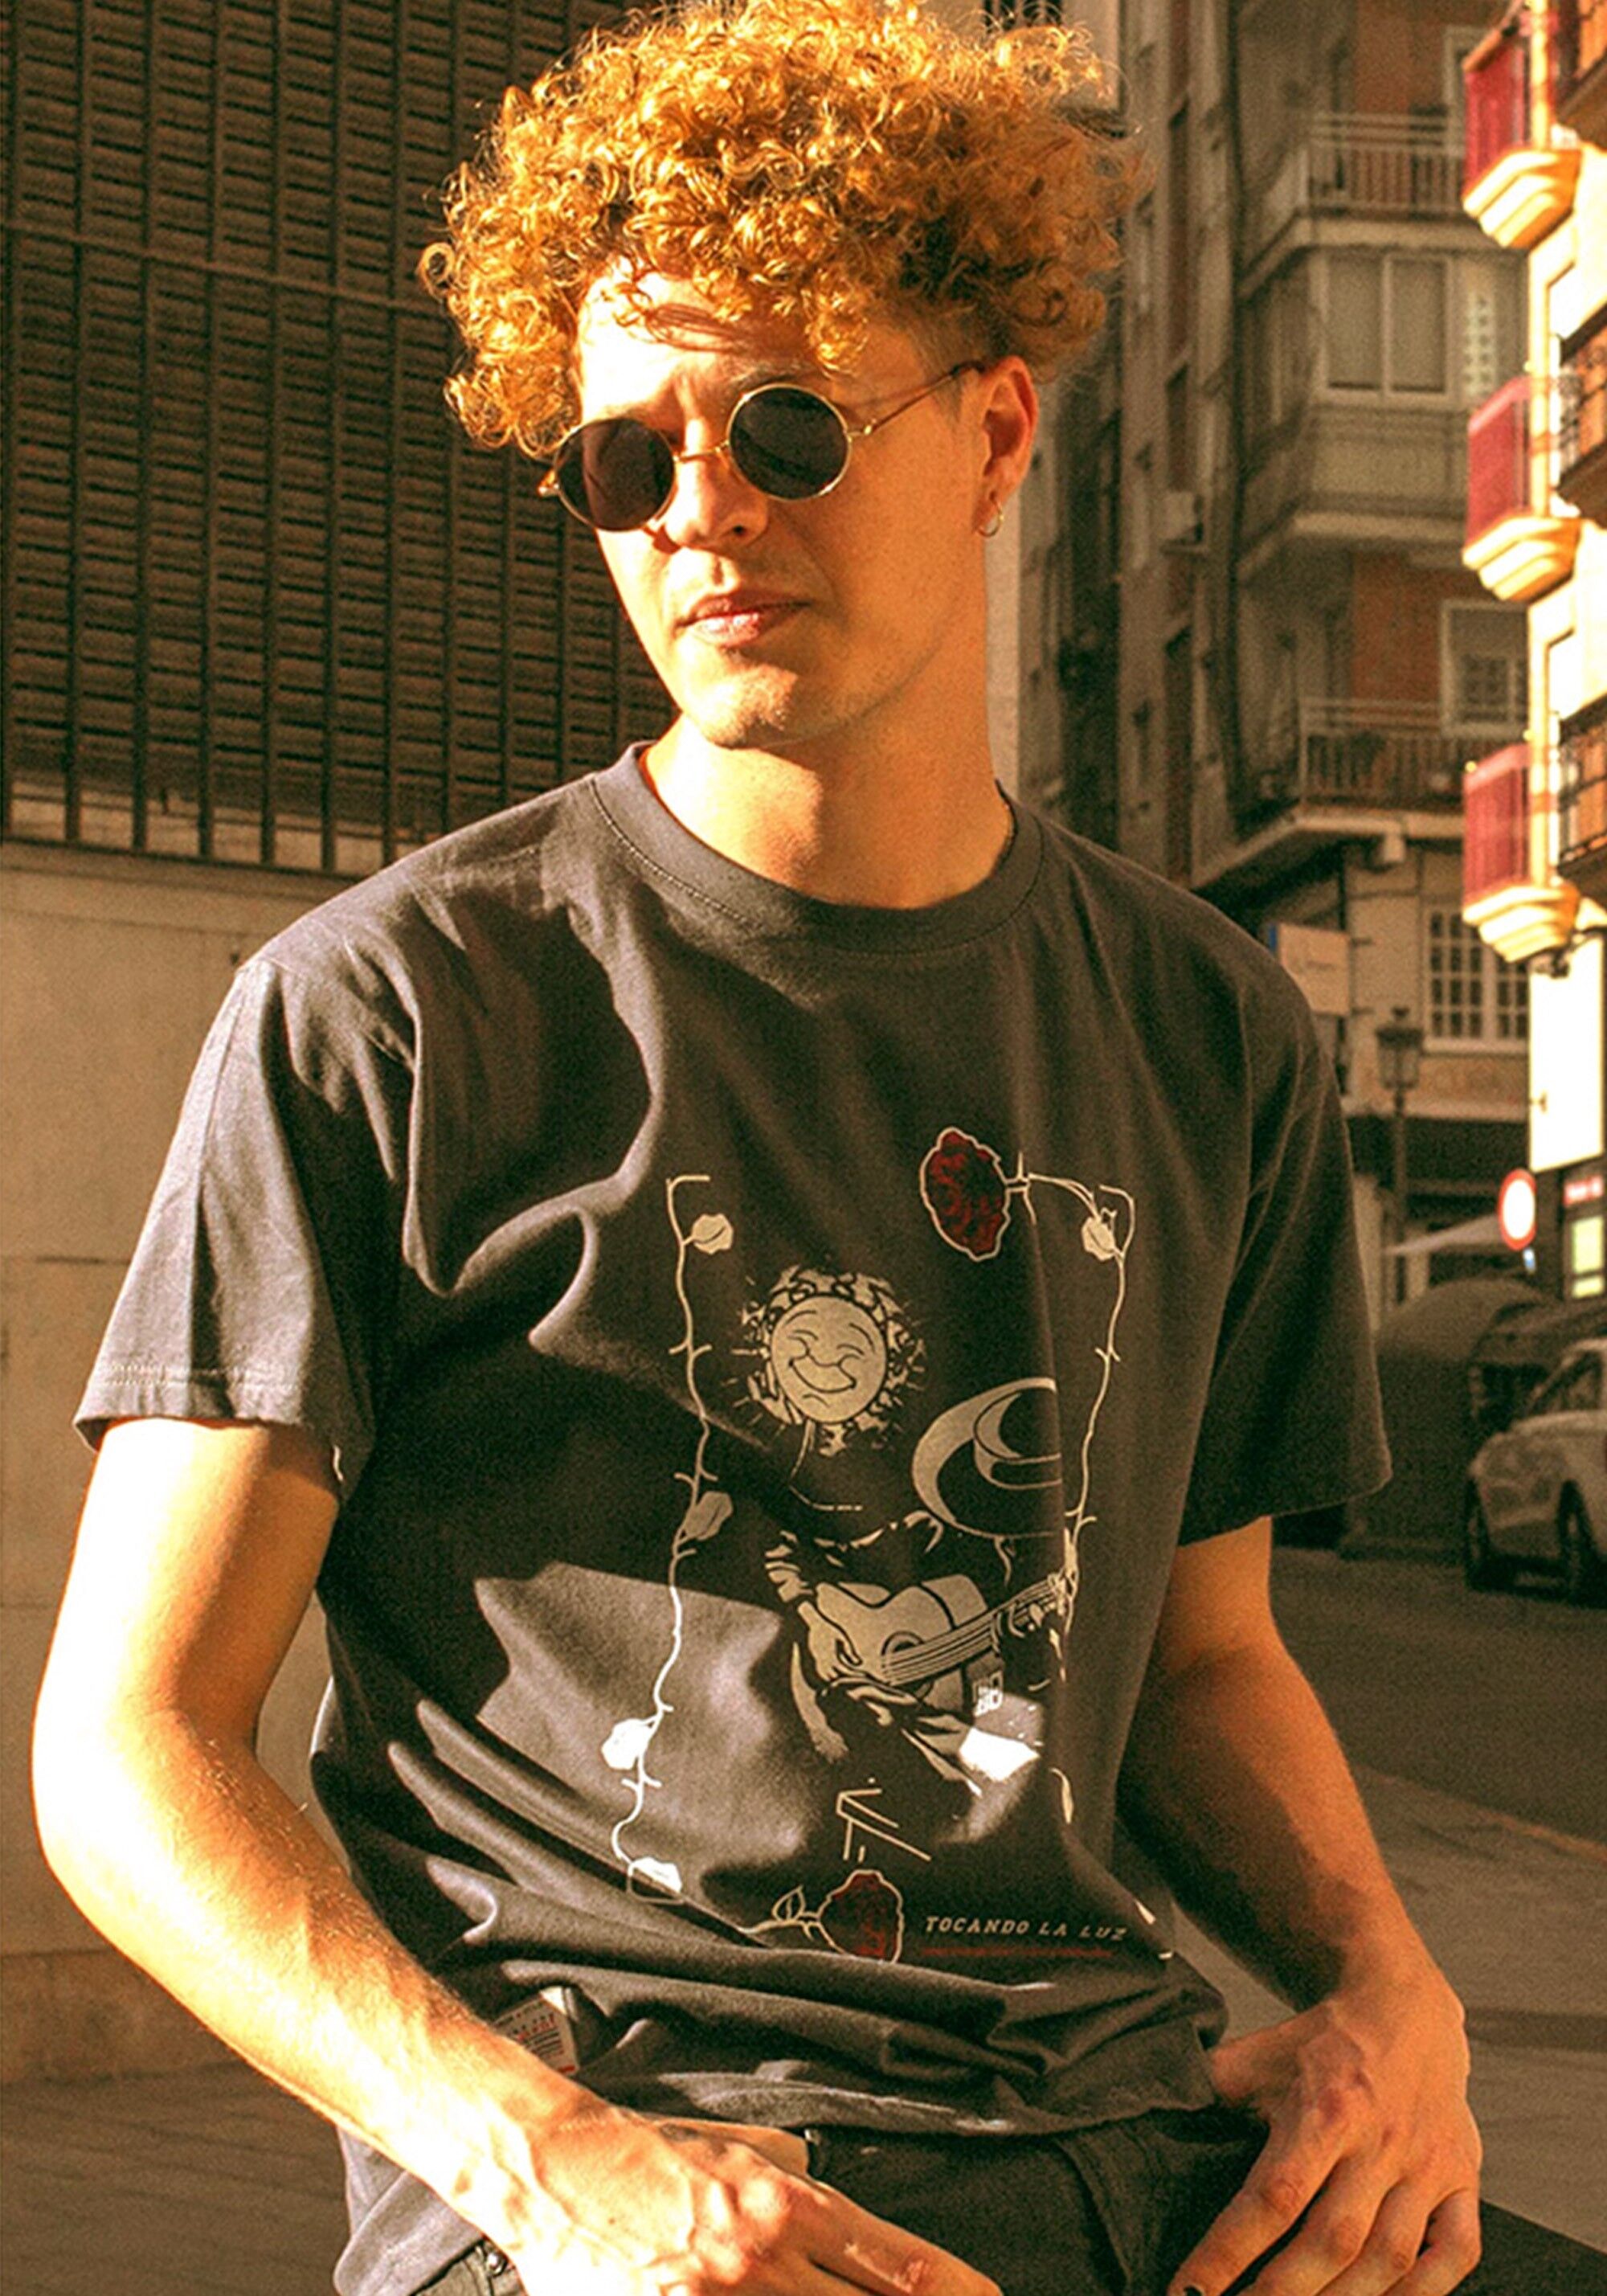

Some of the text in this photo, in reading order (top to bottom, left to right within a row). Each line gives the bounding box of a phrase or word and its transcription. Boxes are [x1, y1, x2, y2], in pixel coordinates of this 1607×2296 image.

[926, 1916, 1127, 1941] TOCANDO LA LUZ
